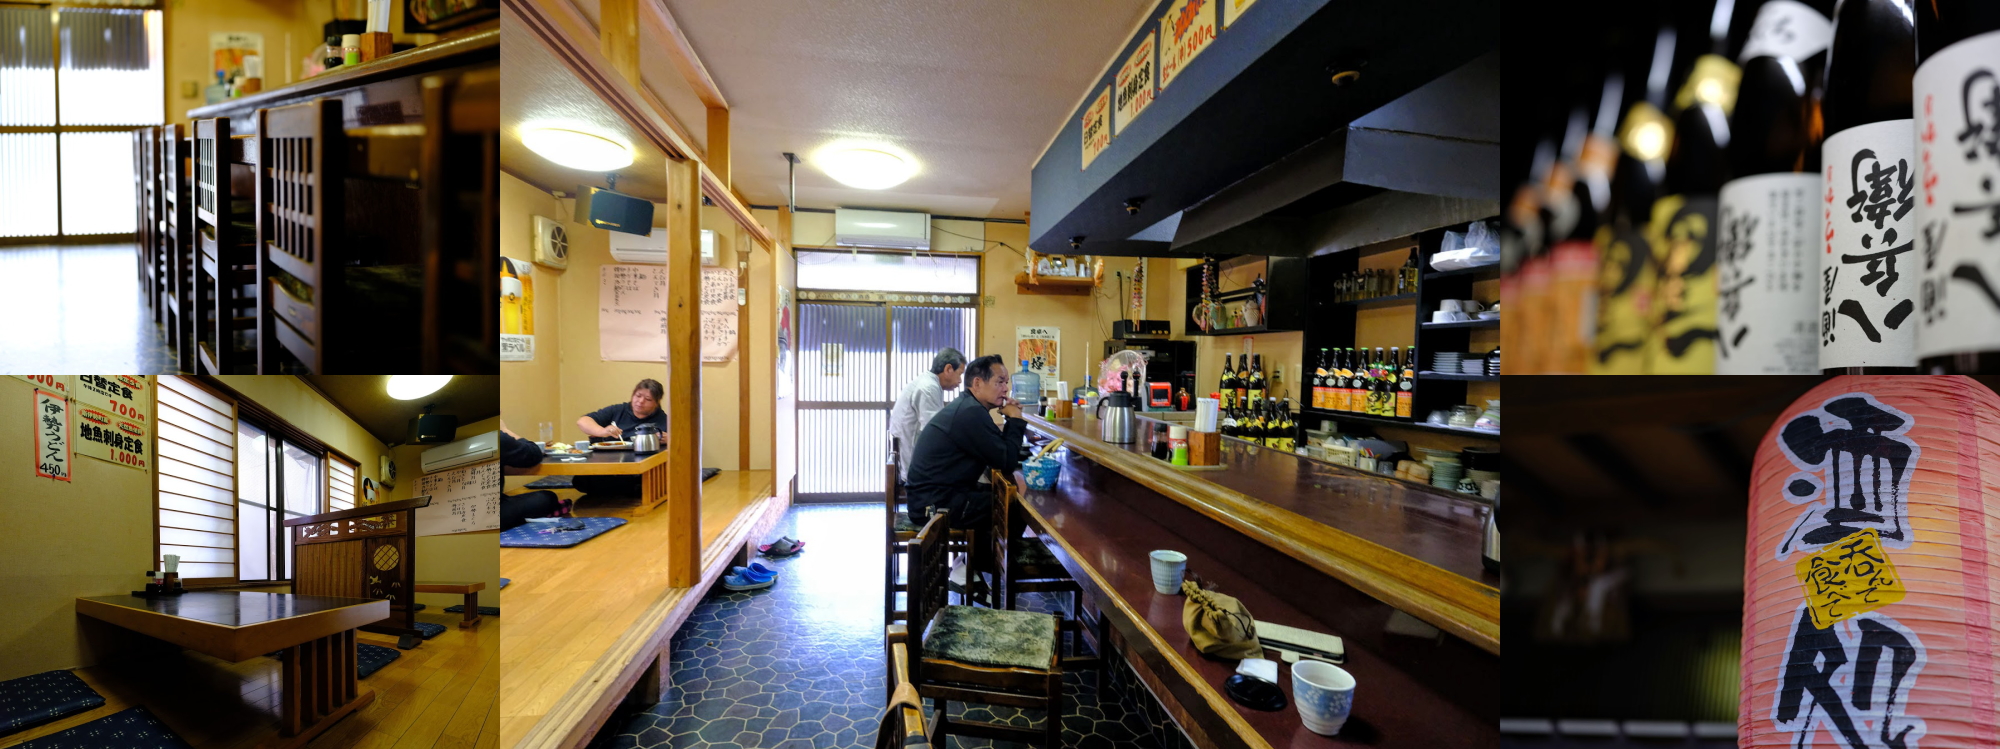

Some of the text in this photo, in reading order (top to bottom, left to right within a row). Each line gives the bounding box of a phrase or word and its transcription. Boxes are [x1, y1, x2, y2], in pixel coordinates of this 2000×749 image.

[1837, 148, 1915, 343] 八兵衛
[1822, 265, 1839, 347] 酒屋
[80, 375, 133, 401] 日替定食
[1031, 356, 1044, 370] 極
[41, 398, 64, 462] 伊勢うどん
[80, 421, 143, 455] 地魚刺身定食
[110, 399, 145, 422] 700円
[40, 462, 67, 478] 450円
[1777, 397, 1916, 749] 酒処
[1805, 557, 1852, 617] 食べて
[1839, 537, 1894, 604] 呑んで
